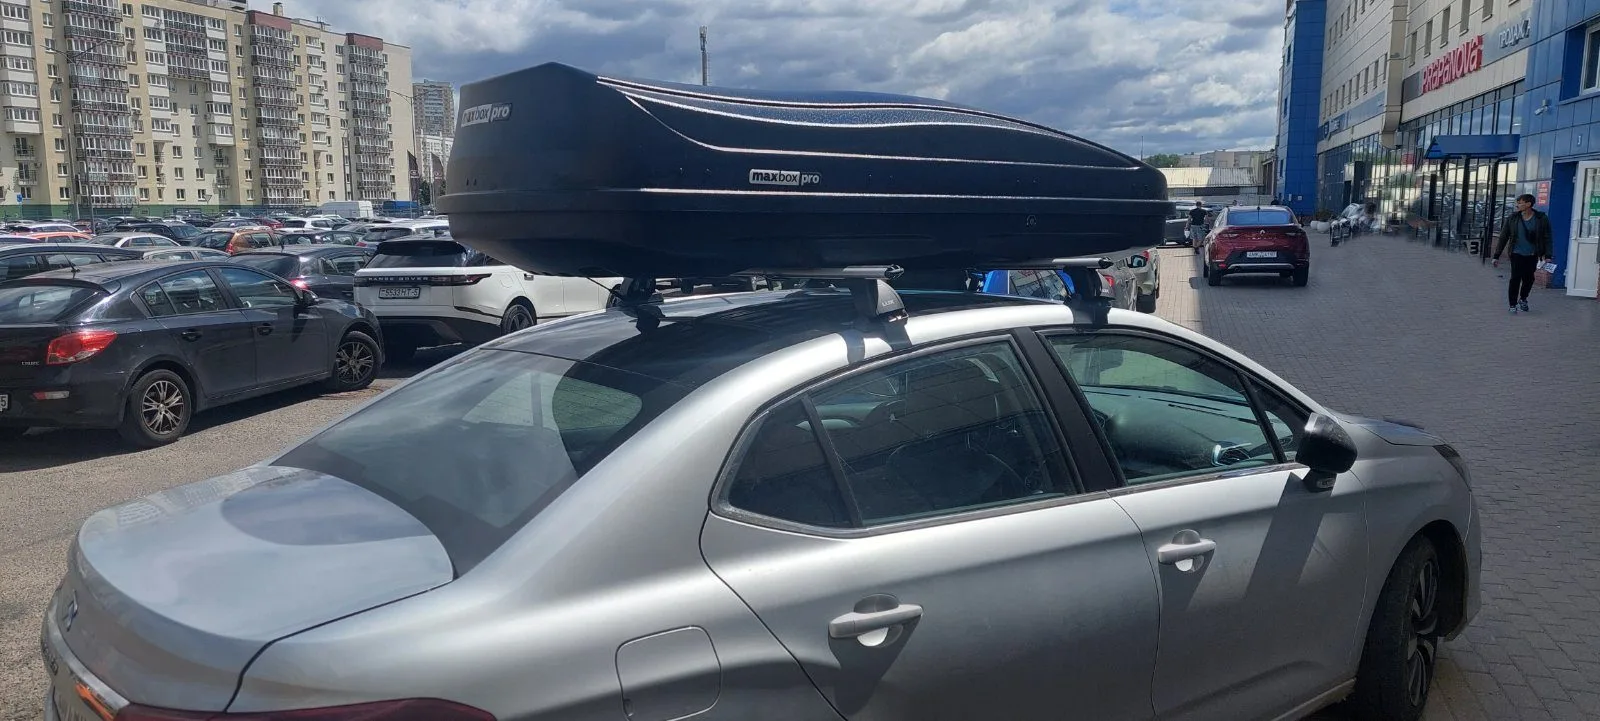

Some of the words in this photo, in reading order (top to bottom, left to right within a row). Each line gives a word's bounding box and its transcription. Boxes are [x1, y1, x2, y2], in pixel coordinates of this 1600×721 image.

[491, 106, 510, 122] pro
[752, 171, 798, 183] maxbox
[801, 174, 820, 186] pro
